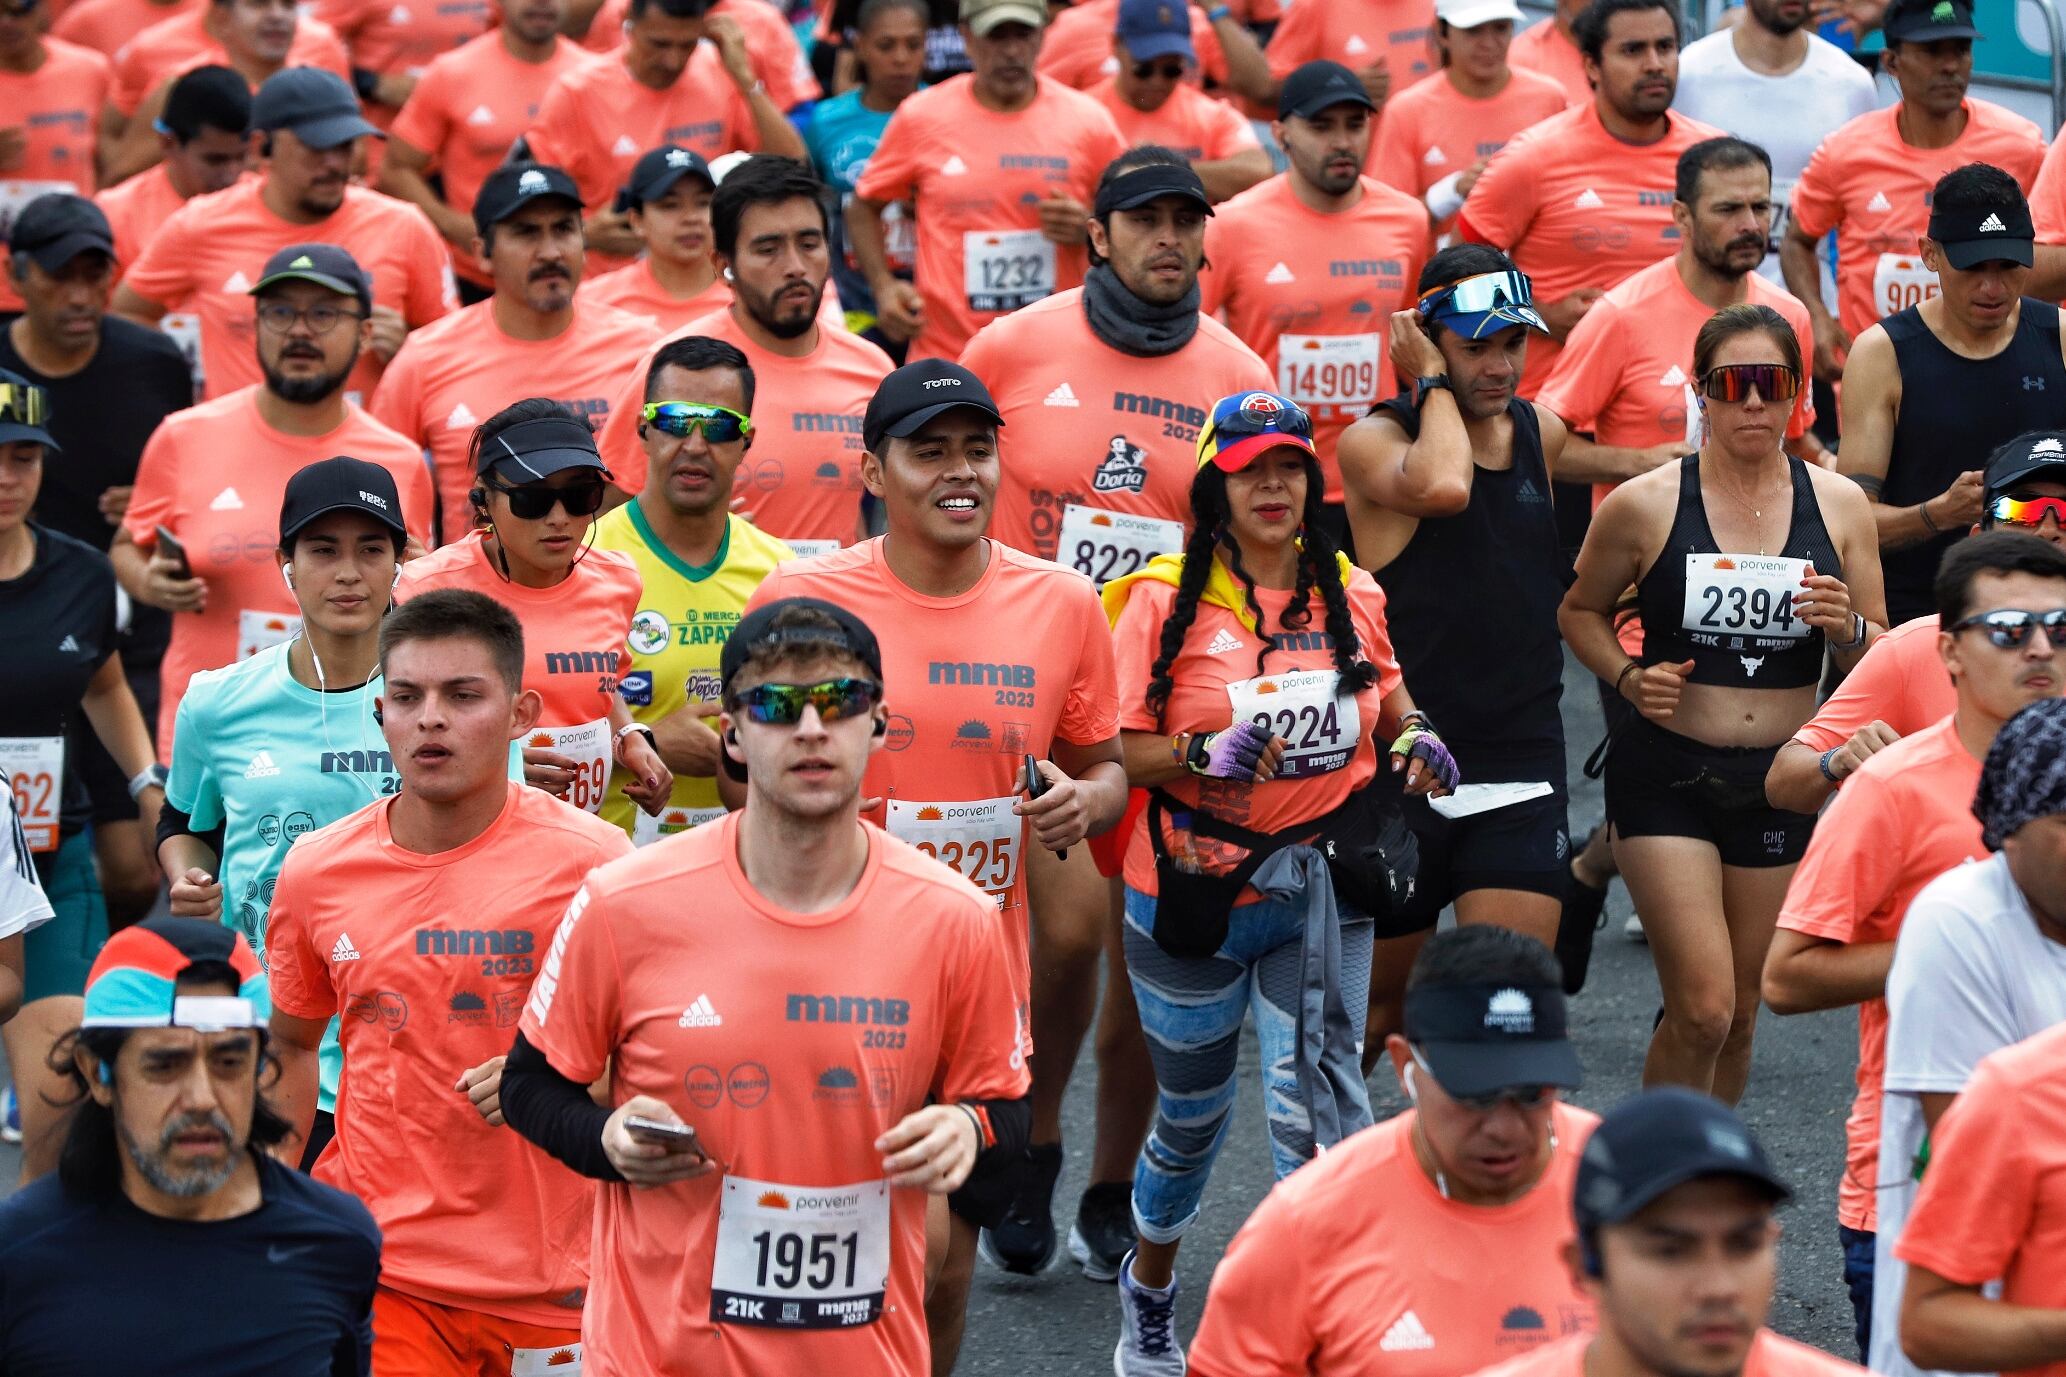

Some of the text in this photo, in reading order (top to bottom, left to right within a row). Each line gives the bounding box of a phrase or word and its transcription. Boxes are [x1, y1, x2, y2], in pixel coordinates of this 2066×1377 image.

[1979, 224, 2006, 232] adidas
[981, 254, 1044, 289] 1232
[922, 378, 962, 390] TOTTO
[1286, 361, 1373, 398] 14909
[1095, 468, 1143, 488] Doria
[1740, 559, 1788, 571] porvenir
[1699, 585, 1794, 631] 2394
[1206, 640, 1244, 655] adidas
[1690, 632, 1721, 647] 21K
[1281, 675, 1325, 692] porvenir
[995, 689, 1036, 709] 2023
[947, 804, 997, 821] porvenir
[287, 822, 311, 832] easy
[1763, 830, 1785, 844] CHC
[332, 950, 360, 962] adidas
[482, 958, 534, 976] 2023
[678, 1014, 723, 1028] adidas
[862, 1029, 907, 1050] 2023
[795, 1193, 860, 1212] porvenir
[753, 1229, 858, 1291] 1951
[724, 1296, 766, 1320] 21K
[840, 1310, 871, 1326] 2023
